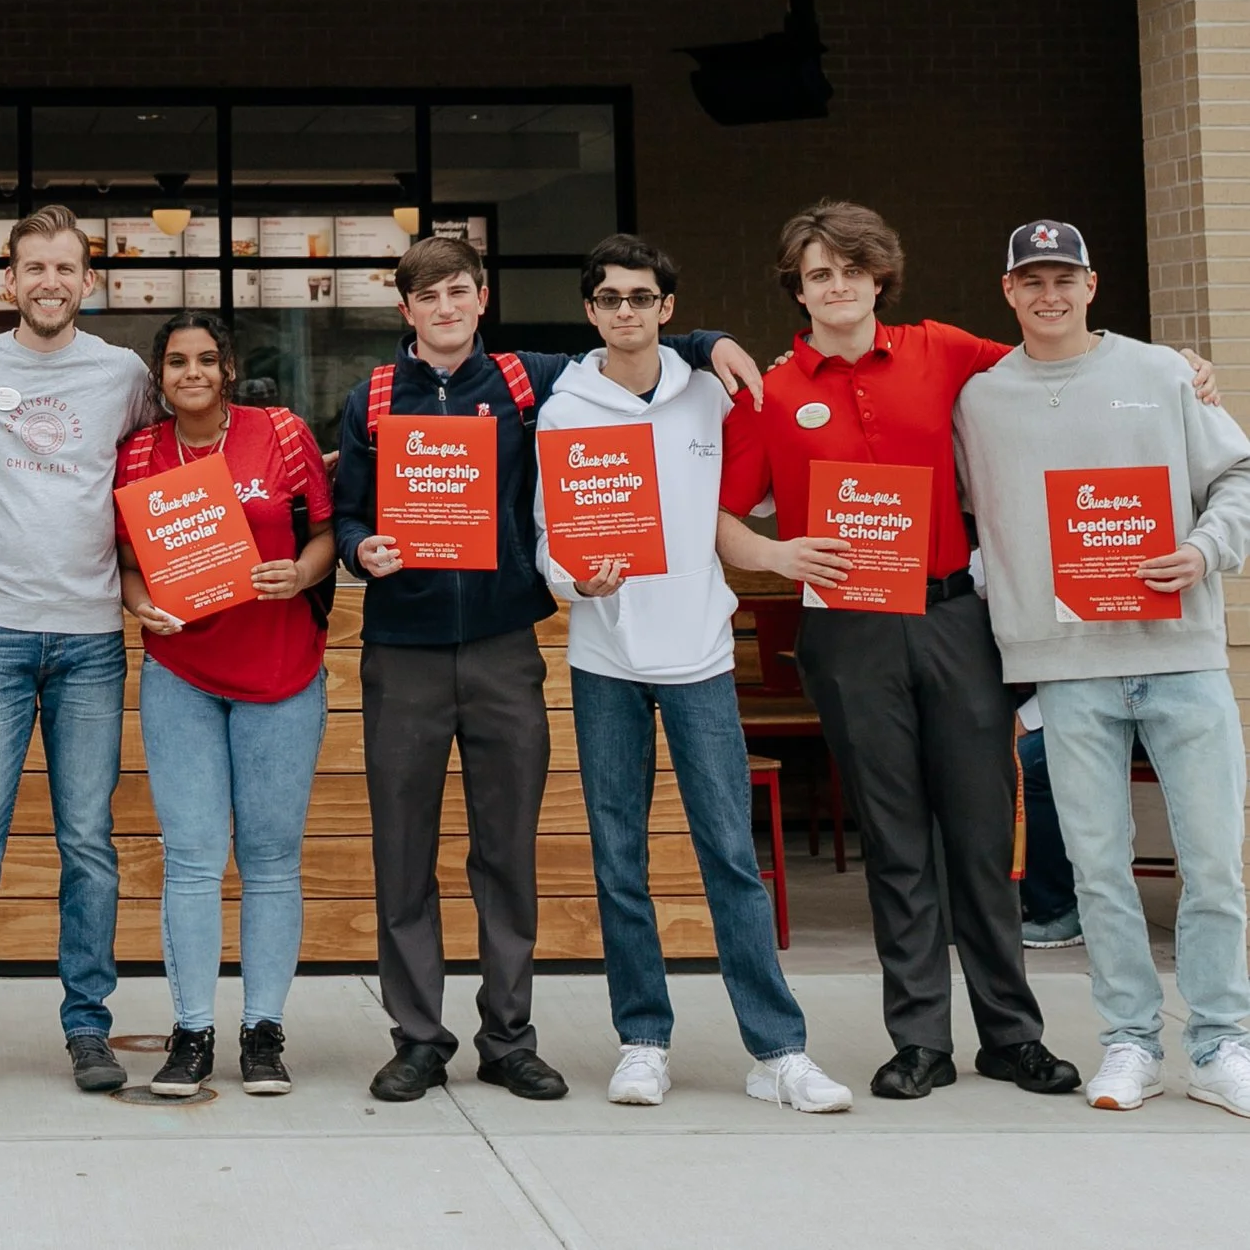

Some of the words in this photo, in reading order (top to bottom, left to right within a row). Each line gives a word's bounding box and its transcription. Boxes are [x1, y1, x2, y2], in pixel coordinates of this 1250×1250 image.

[406, 430, 467, 457] Chick-fil-A
[568, 442, 629, 468] Chick-fil-A
[396, 463, 479, 482] Leadership
[560, 472, 642, 495] Leadership
[408, 478, 466, 492] Scholar
[574, 486, 631, 505] Scholar
[838, 478, 900, 505] Chick-fil-A
[148, 487, 208, 516] Chick-fil-A
[1076, 484, 1141, 510] Chick-fil-A
[146, 505, 225, 542] Leadership
[826, 509, 912, 530] Leadership
[1068, 515, 1156, 536] Leadership
[163, 518, 217, 550] Scholar
[838, 524, 899, 540] Scholar
[1082, 529, 1143, 546] Scholar
